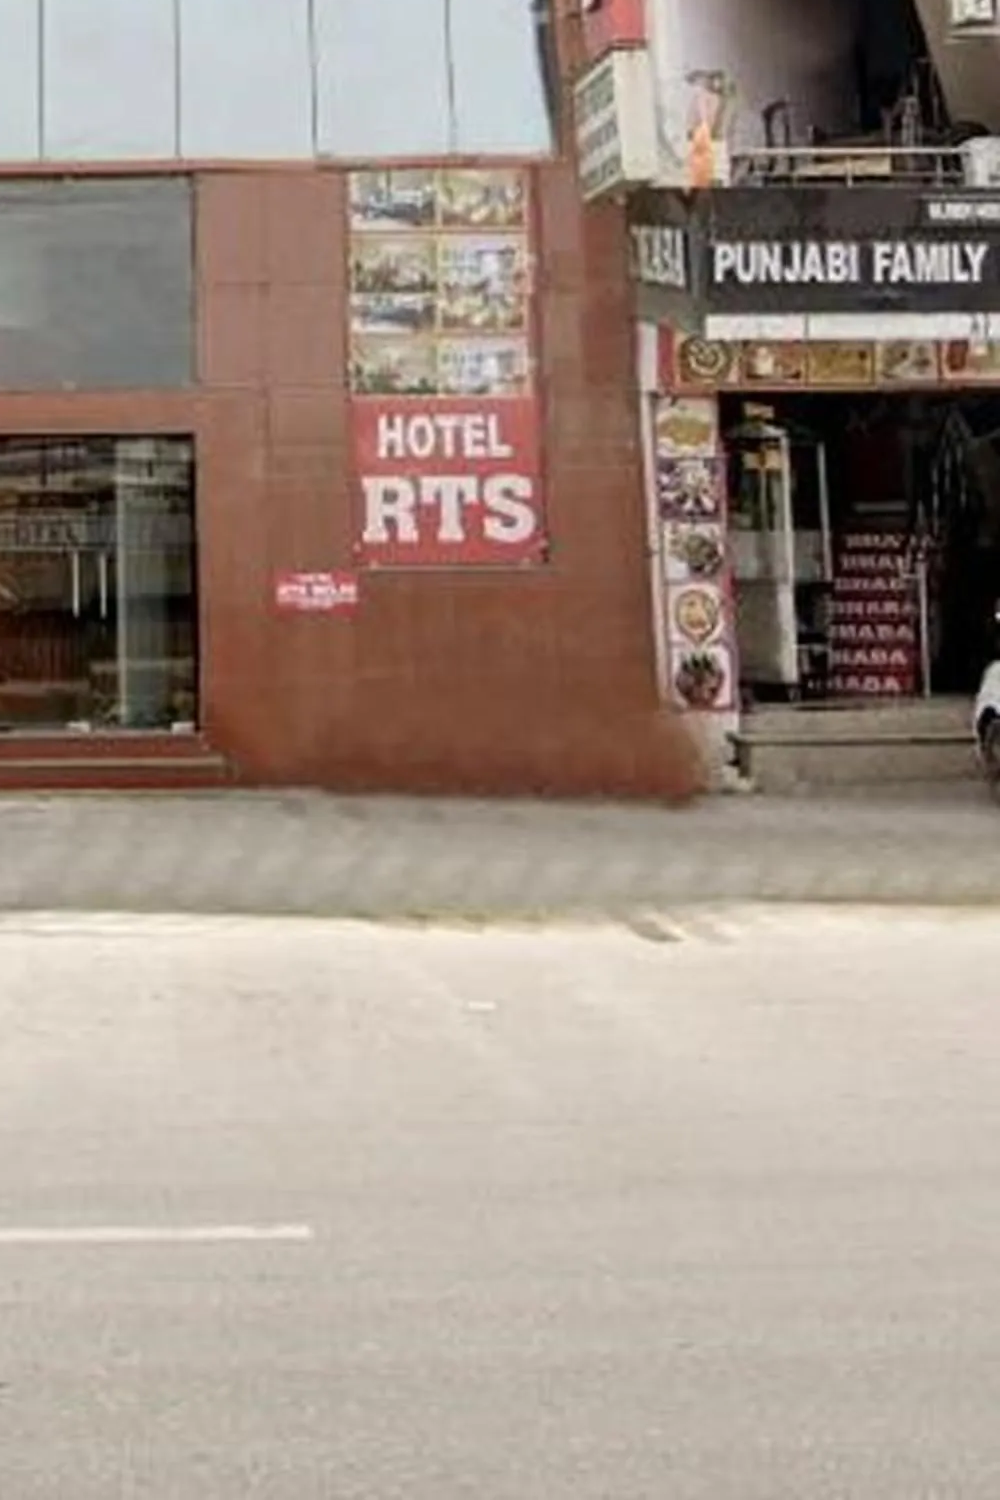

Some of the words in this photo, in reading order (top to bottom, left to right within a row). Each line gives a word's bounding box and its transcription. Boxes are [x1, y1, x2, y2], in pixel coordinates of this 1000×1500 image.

[714, 241, 860, 283] PUNJABI
[873, 241, 989, 283] FAMILY
[377, 414, 514, 460] HOTEL
[361, 473, 538, 544] RTS
